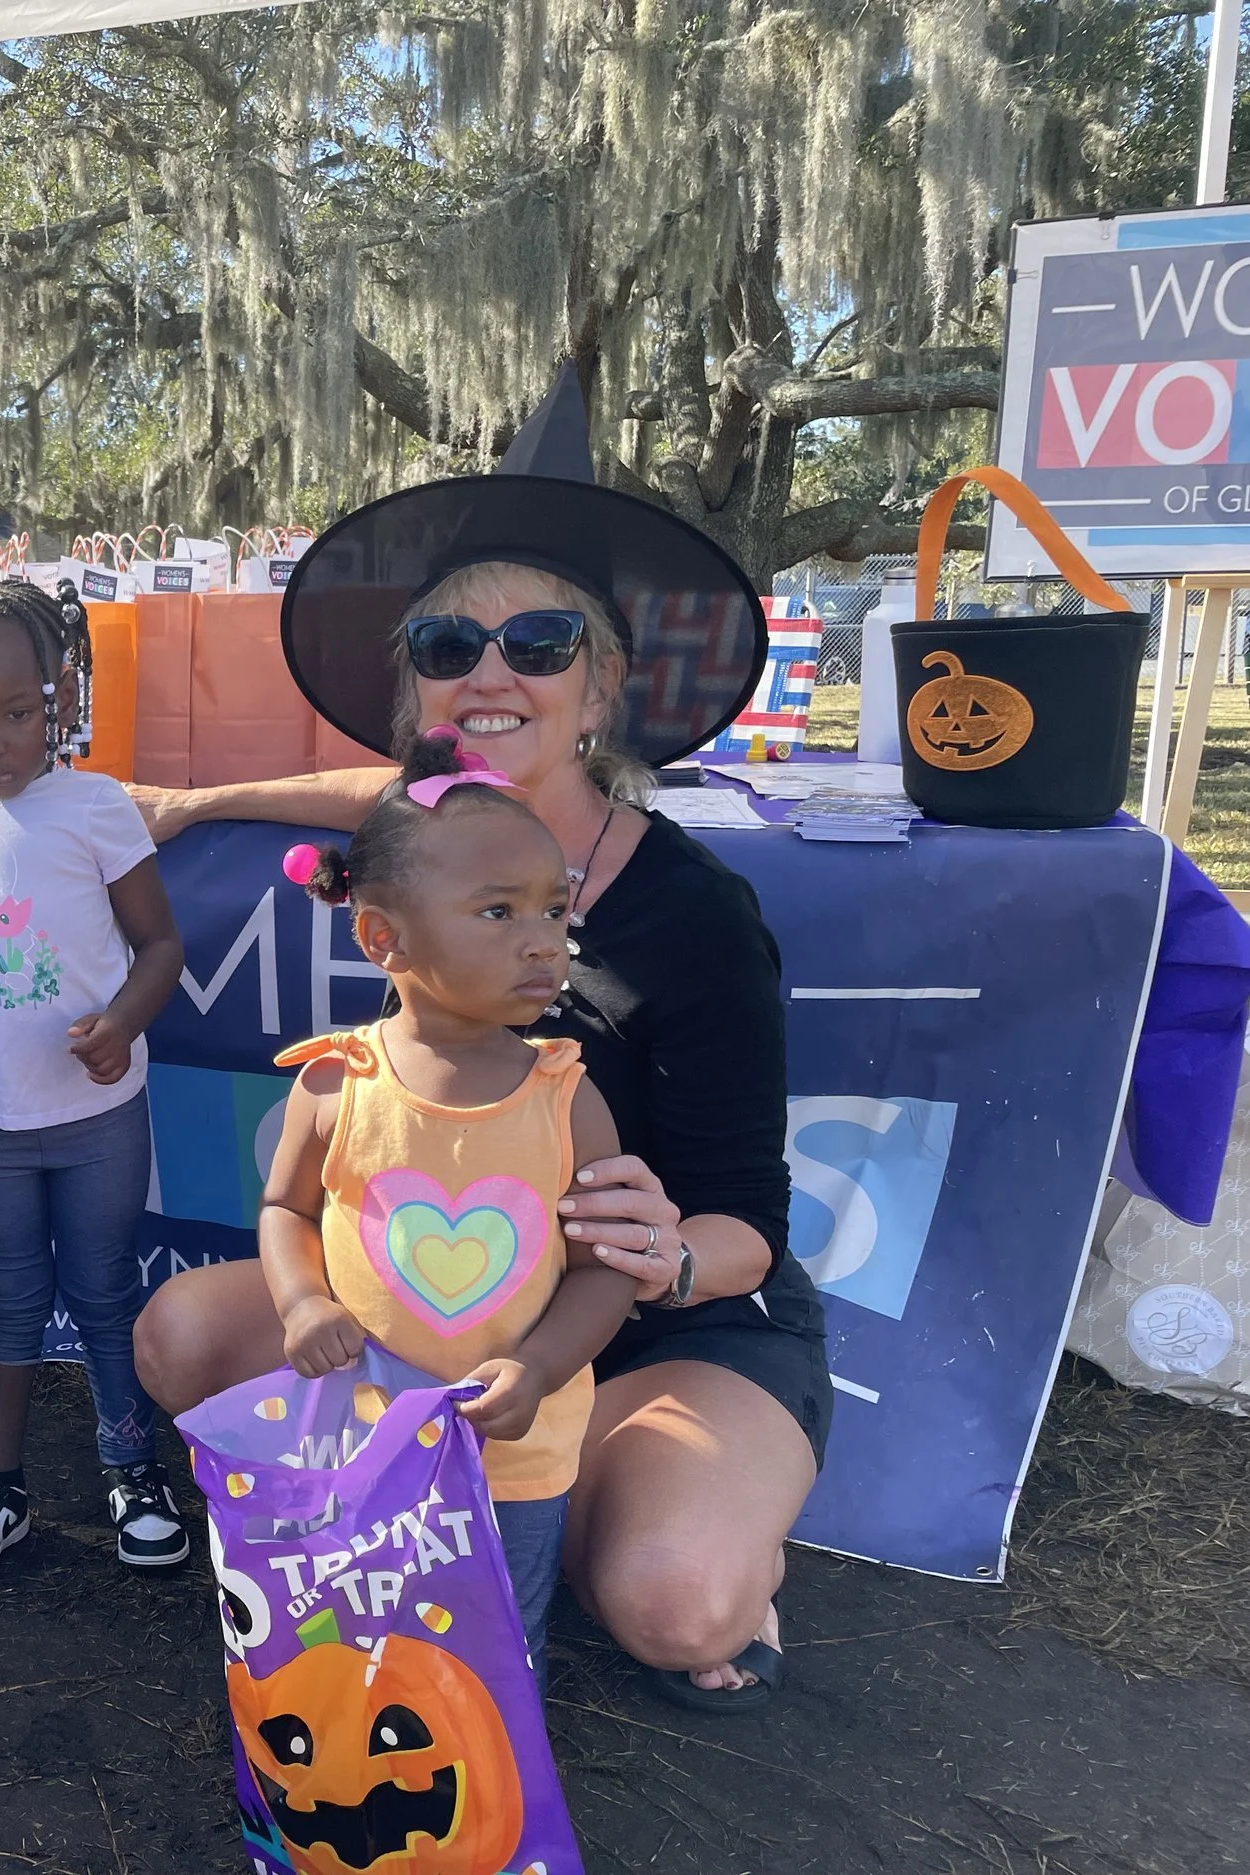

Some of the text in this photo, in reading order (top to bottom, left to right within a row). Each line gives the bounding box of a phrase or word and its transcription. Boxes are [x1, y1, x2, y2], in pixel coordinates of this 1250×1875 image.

[1050, 360, 1233, 468] VO
[1164, 484, 1210, 514] OF
[157, 576, 190, 586] VOICES
[161, 569, 186, 577] WOMEN'S
[85, 580, 113, 596] VOICES
[286, 1587, 323, 1619] OR
[330, 1510, 474, 1618] TRAT
